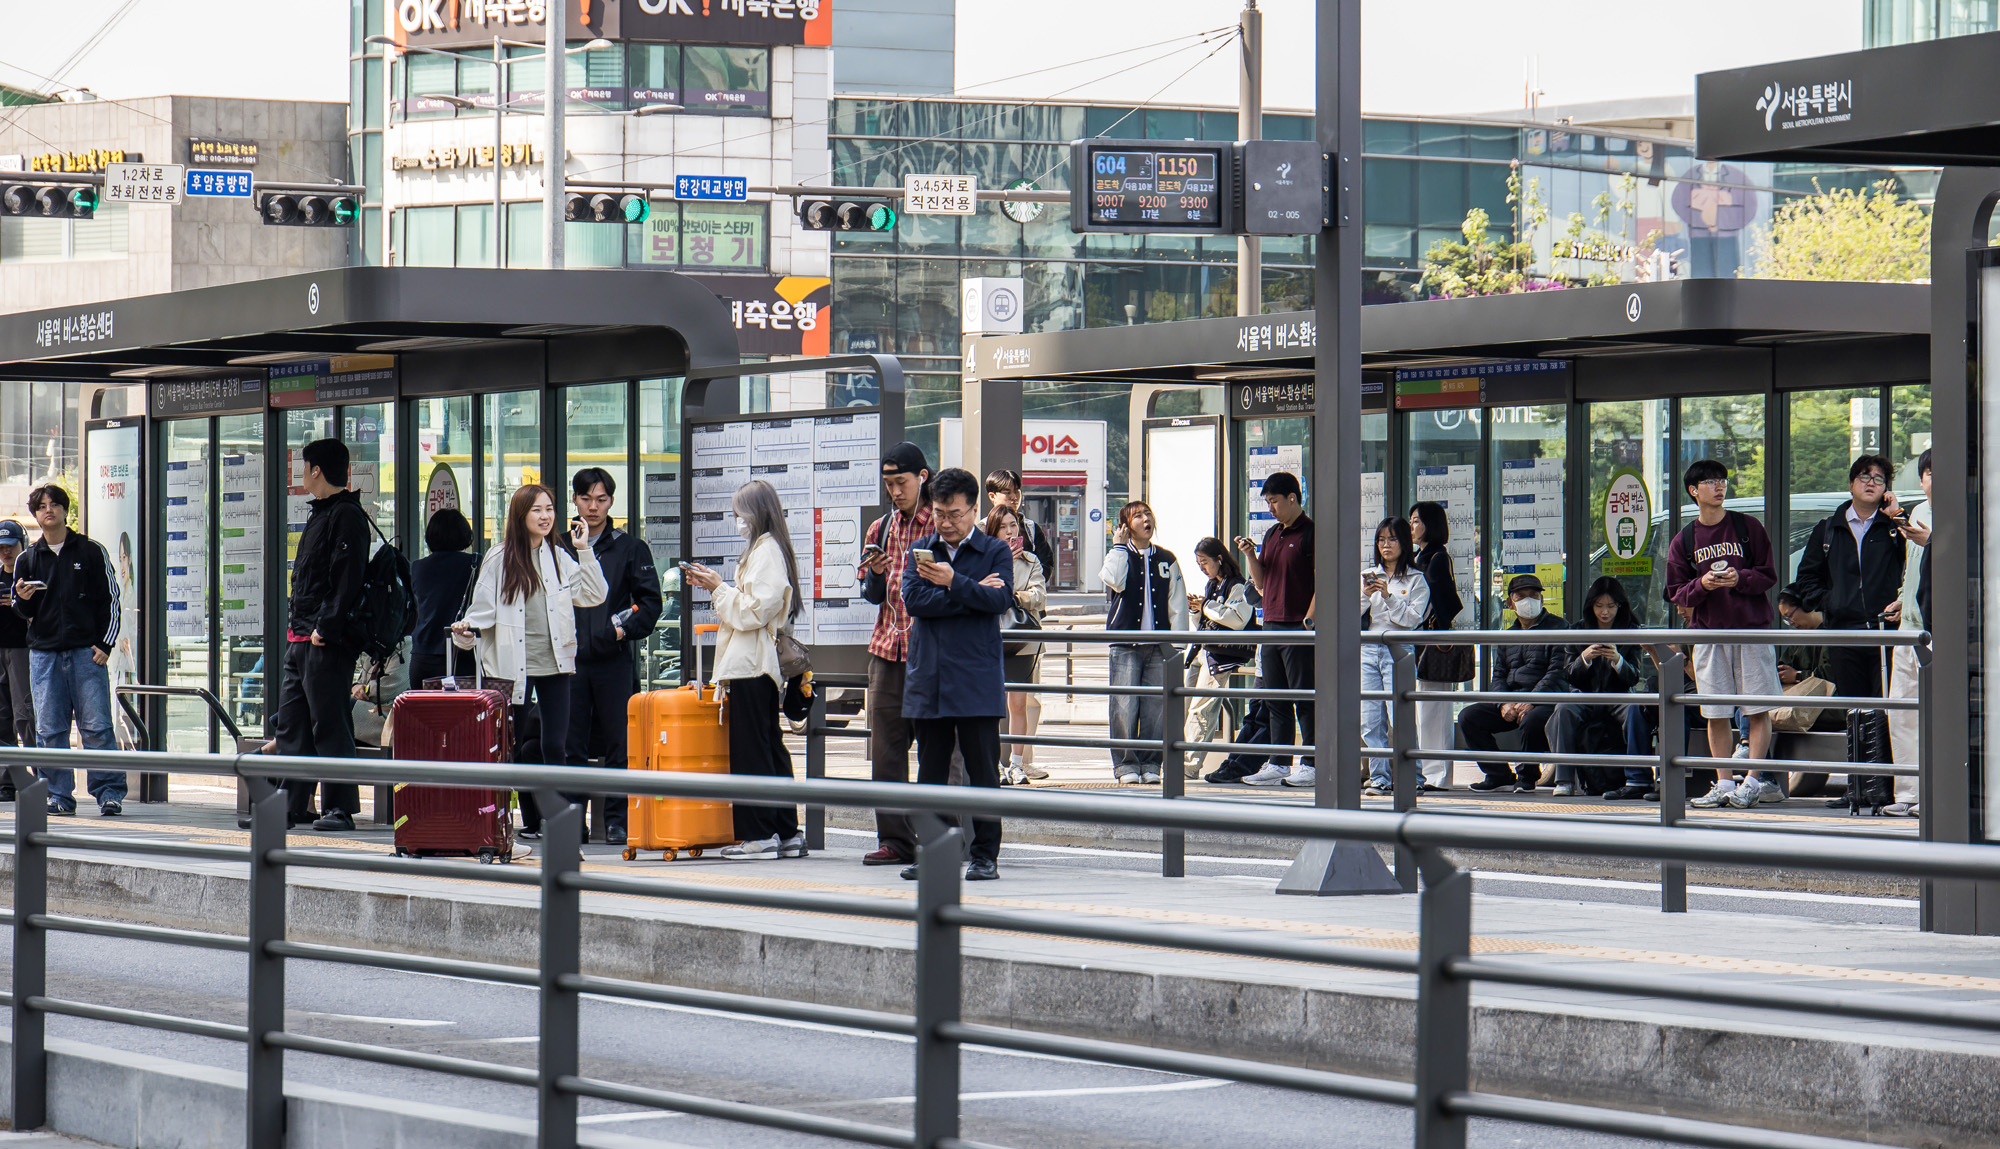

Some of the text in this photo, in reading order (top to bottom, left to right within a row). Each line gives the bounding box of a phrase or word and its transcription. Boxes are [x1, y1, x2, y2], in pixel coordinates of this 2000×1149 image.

[570, 89, 612, 99] OK 저축은행
[633, 90, 675, 100] OK 저축은행
[705, 93, 746, 102] OK 저축은행
[1781, 79, 1852, 117] 서울특별시
[1782, 113, 1852, 130] SEOUL METROPOLITAN GOVERNMENT
[1096, 155, 1127, 175] 604
[1158, 157, 1198, 176] 1150
[191, 173, 248, 194] 후암동방면
[679, 178, 744, 198] 한강대교방면
[1096, 179, 1153, 191] 곧도착 다음 10분
[1158, 180, 1215, 192] 곧도착 다음 12분
[111, 185, 176, 201] 좌회전전용
[1097, 194, 1208, 209] 9007 9200 9300
[911, 195, 971, 211] 직진전용
[1100, 208, 1201, 220] 14분 17분 8분
[652, 219, 678, 233] 100%
[723, 221, 754, 236] 스타키
[36, 310, 114, 348] 서울역 버스환승센터
[1236, 324, 1272, 352] 서울역
[965, 344, 976, 373] 4
[1003, 347, 1031, 364] 서울특별시
[1276, 404, 1285, 412] Seoul
[1286, 403, 1298, 411] Station
[1853, 430, 1860, 446] 3
[1869, 430, 1876, 446] 3
[1609, 491, 1644, 513] 금연 버스
[1158, 561, 1170, 579] C
